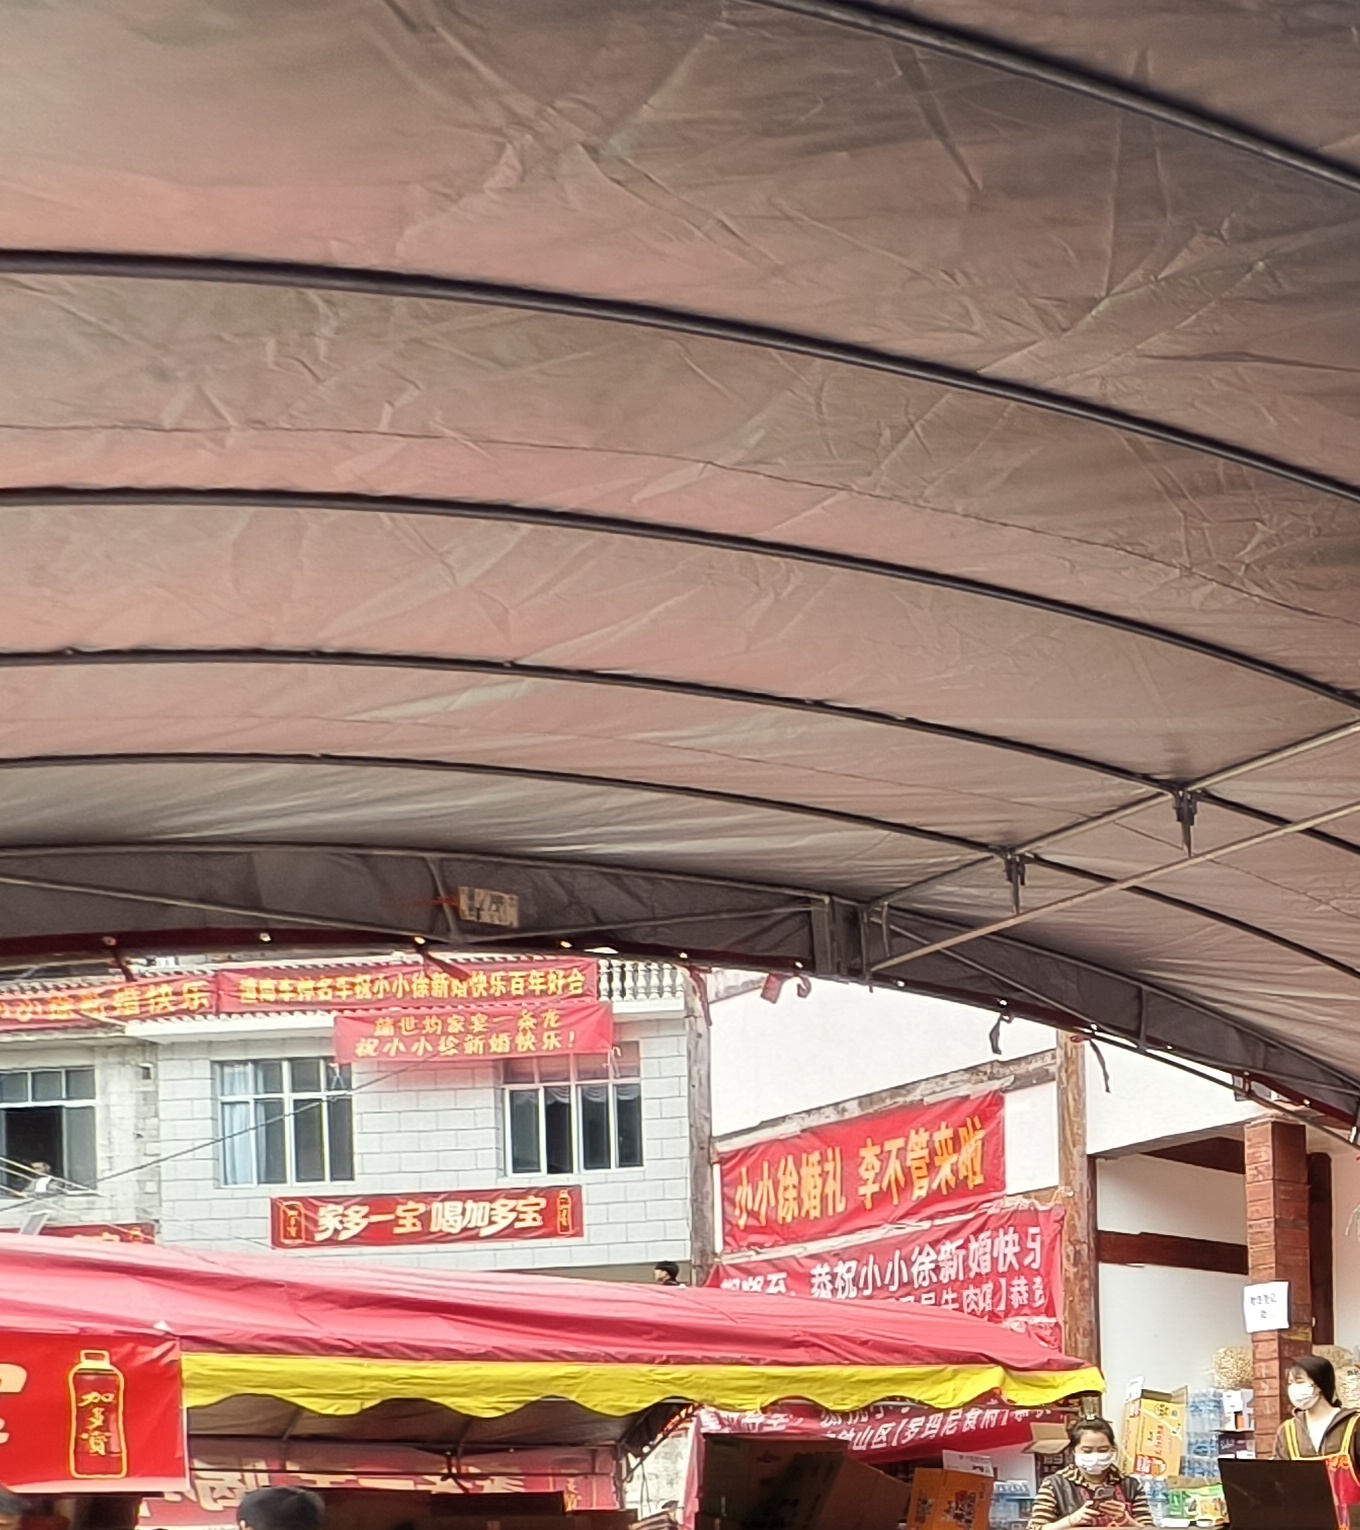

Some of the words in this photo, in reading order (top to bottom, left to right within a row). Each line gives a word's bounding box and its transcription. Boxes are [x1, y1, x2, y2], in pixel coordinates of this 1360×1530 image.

[735, 1146, 846, 1230] 小小徐婚礼
